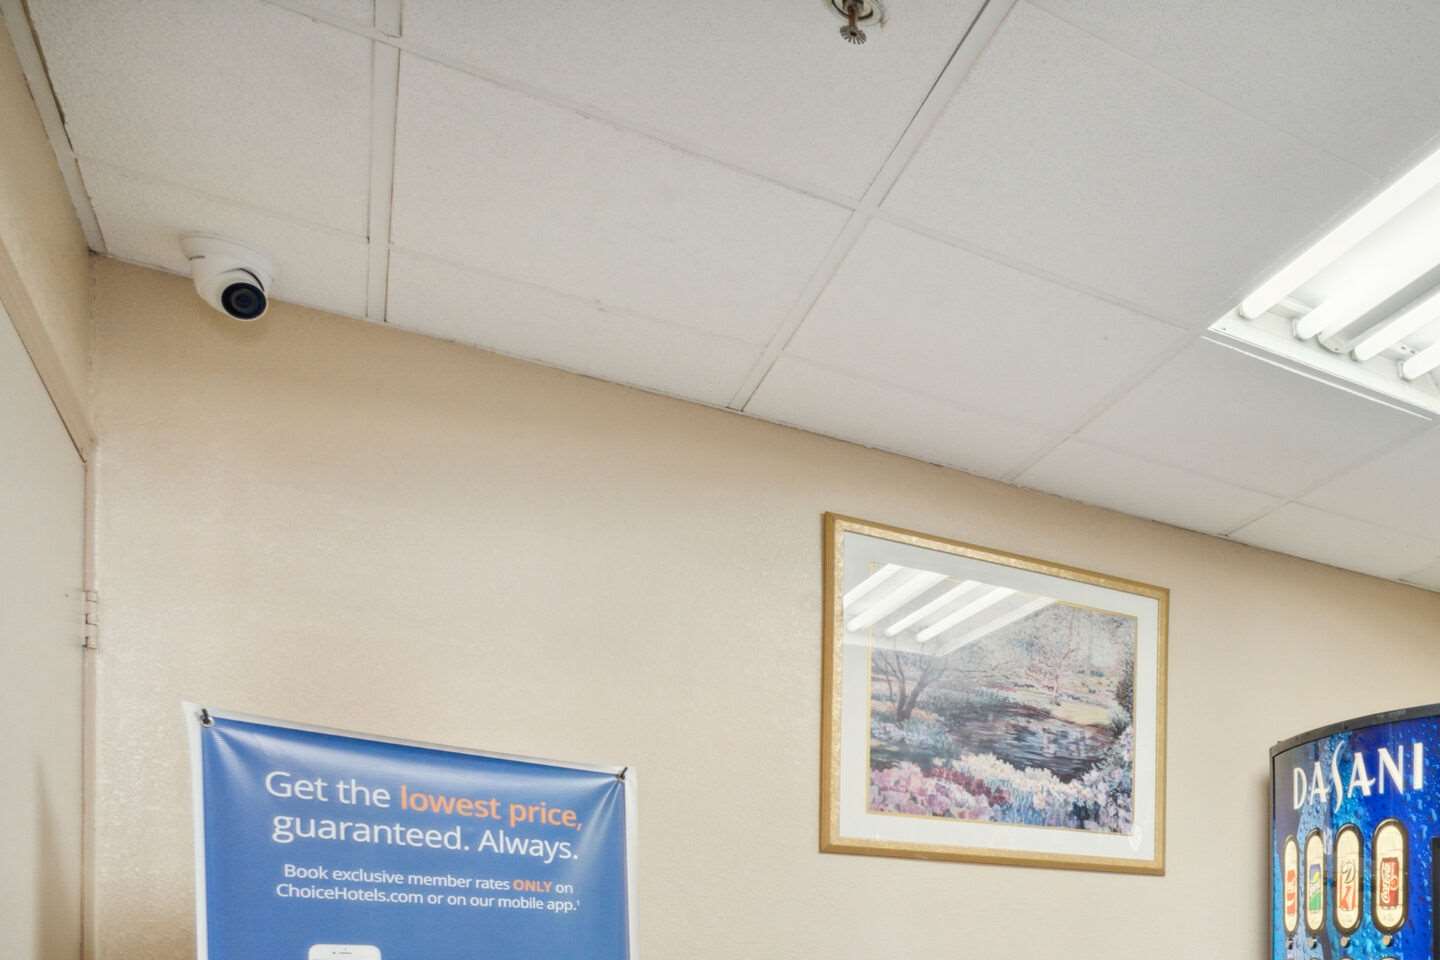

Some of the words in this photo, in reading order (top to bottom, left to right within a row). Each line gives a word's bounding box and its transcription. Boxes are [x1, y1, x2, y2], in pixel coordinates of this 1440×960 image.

[265, 771, 328, 801] Get
[336, 779, 391, 808] the
[401, 784, 501, 820] lowest
[509, 801, 583, 832] price,
[1292, 740, 1424, 814] DASANI
[272, 812, 470, 851] guaranteed.
[478, 829, 580, 865] Always.
[276, 882, 424, 905] ChoiceHotels.com
[427, 893, 445, 905] or
[448, 894, 467, 907] on
[470, 895, 495, 908] our
[498, 892, 544, 911] mobile
[283, 862, 328, 881] Book
[332, 868, 404, 886] exclusive
[408, 872, 472, 890] member
[475, 875, 511, 892] rates
[513, 878, 553, 894] ONLY
[555, 882, 574, 895] on
